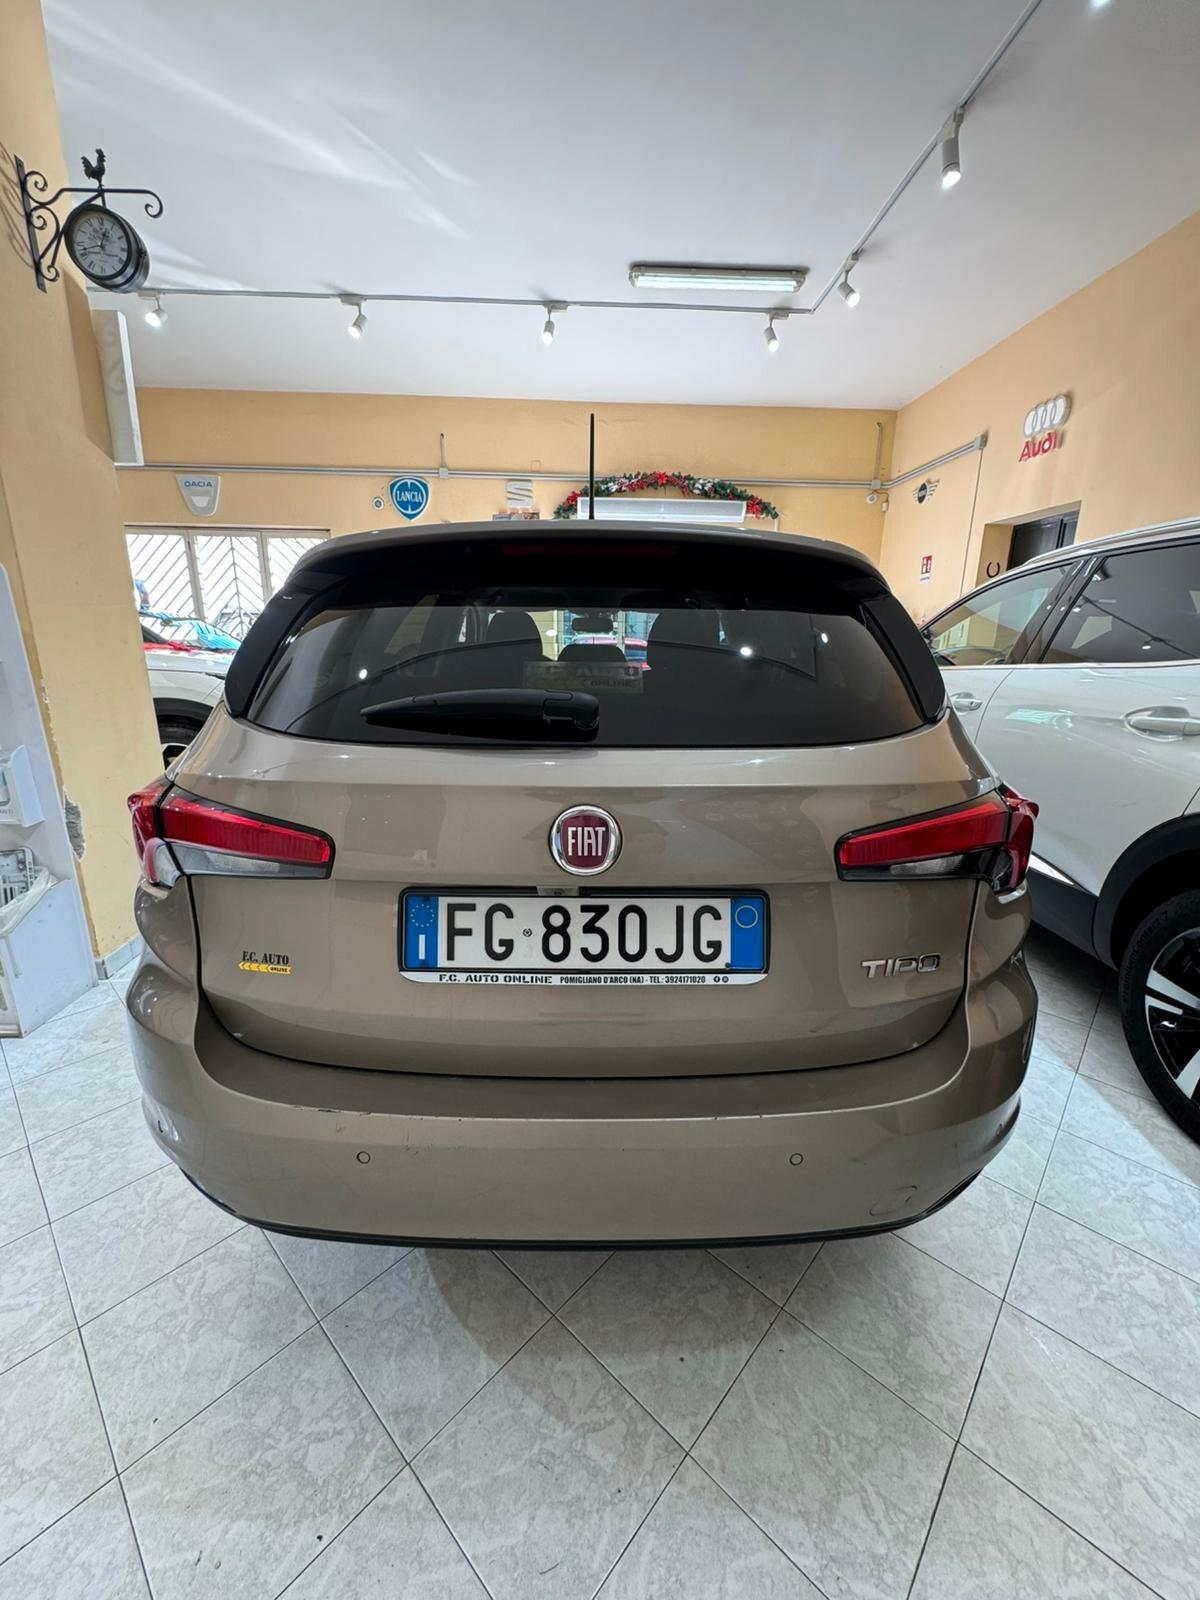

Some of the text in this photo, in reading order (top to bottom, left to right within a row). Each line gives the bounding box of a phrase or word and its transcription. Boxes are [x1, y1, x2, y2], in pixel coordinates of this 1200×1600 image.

[1018, 432, 1058, 462] Audi
[396, 490, 423, 503] LANCIA
[567, 826, 606, 857] FIAT
[446, 902, 723, 963] FG 830JG
[242, 951, 289, 965] F.C. AUTO
[860, 952, 941, 979] TIPO
[439, 973, 461, 982] F.C.
[465, 974, 500, 983] AUTO
[503, 975, 553, 984] ONLINE
[560, 975, 602, 984] POMIGLIANO
[603, 975, 628, 984] D'ARCO
[629, 975, 644, 984] (NA)
